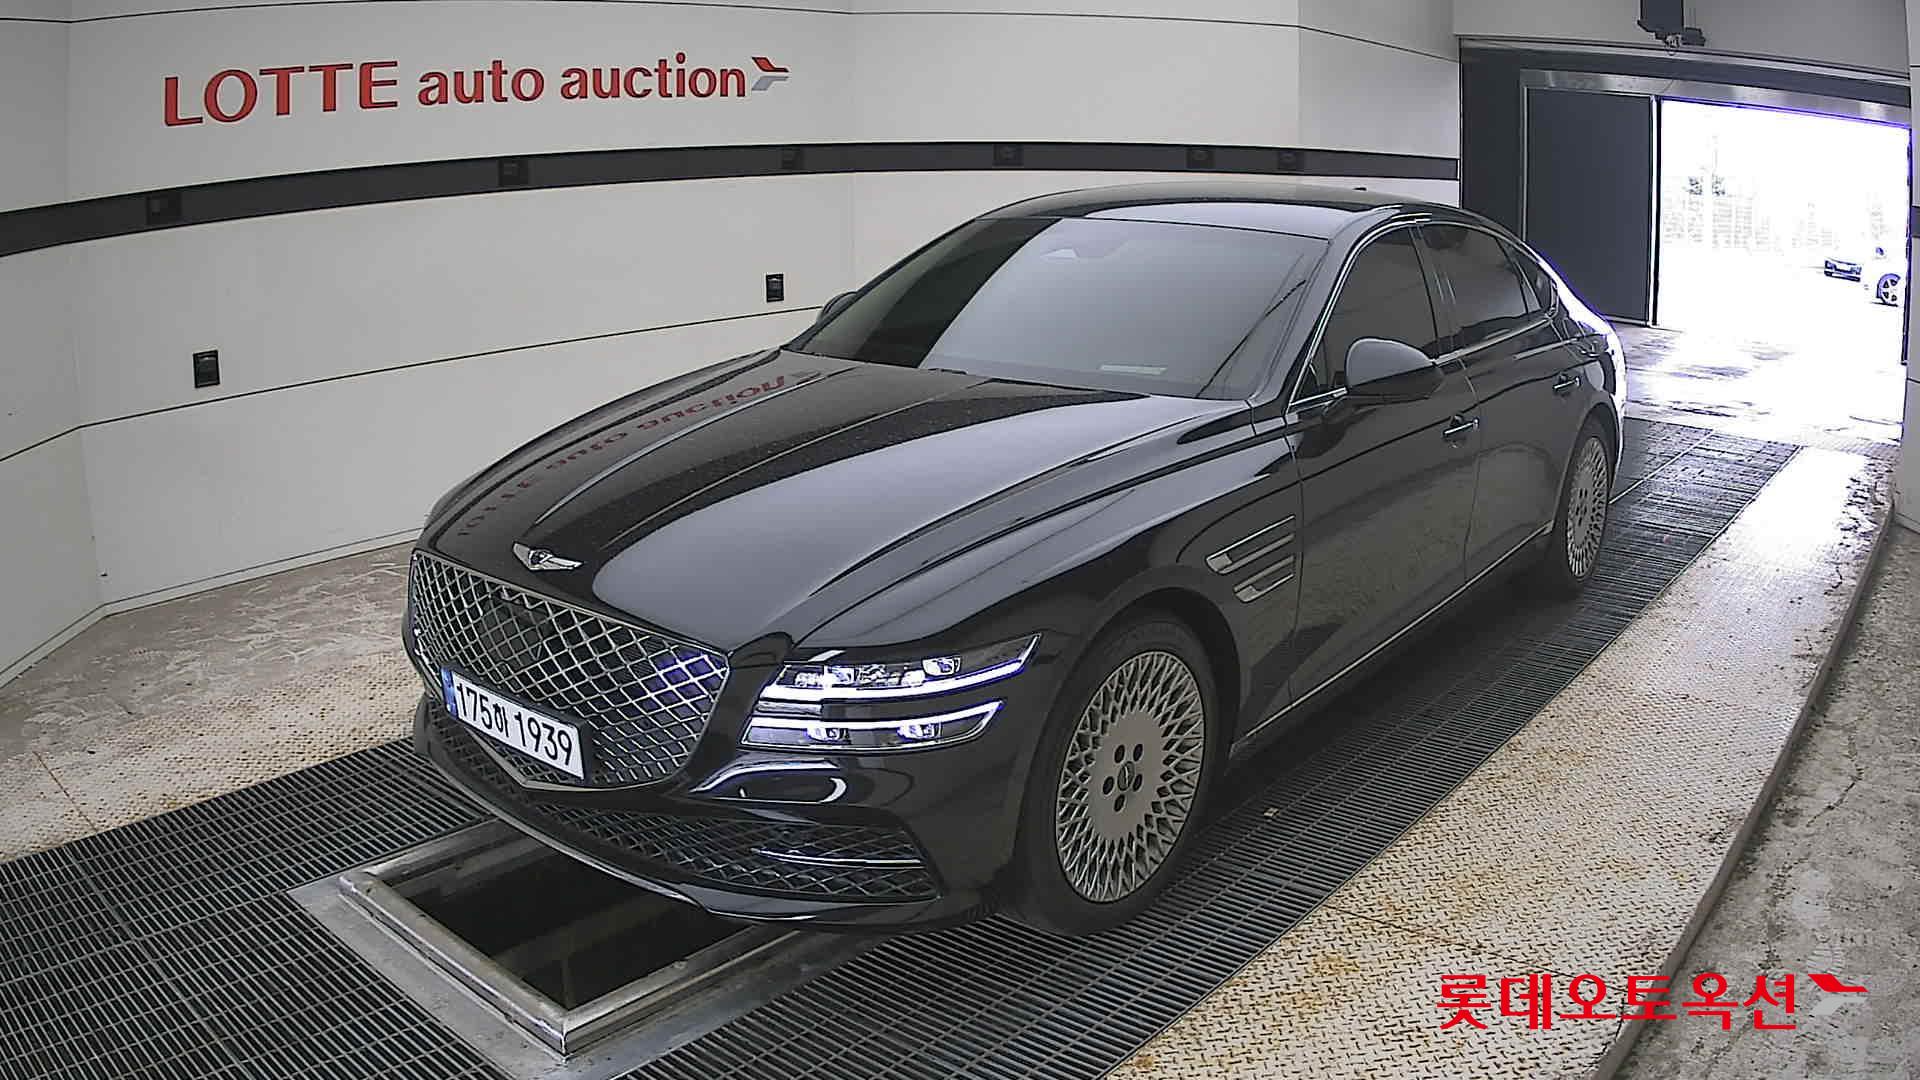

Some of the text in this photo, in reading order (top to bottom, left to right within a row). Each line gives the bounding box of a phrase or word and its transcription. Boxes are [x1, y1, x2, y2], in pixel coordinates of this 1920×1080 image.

[163, 52, 748, 127] LOTTE auto auction
[514, 711, 573, 766] 1939
